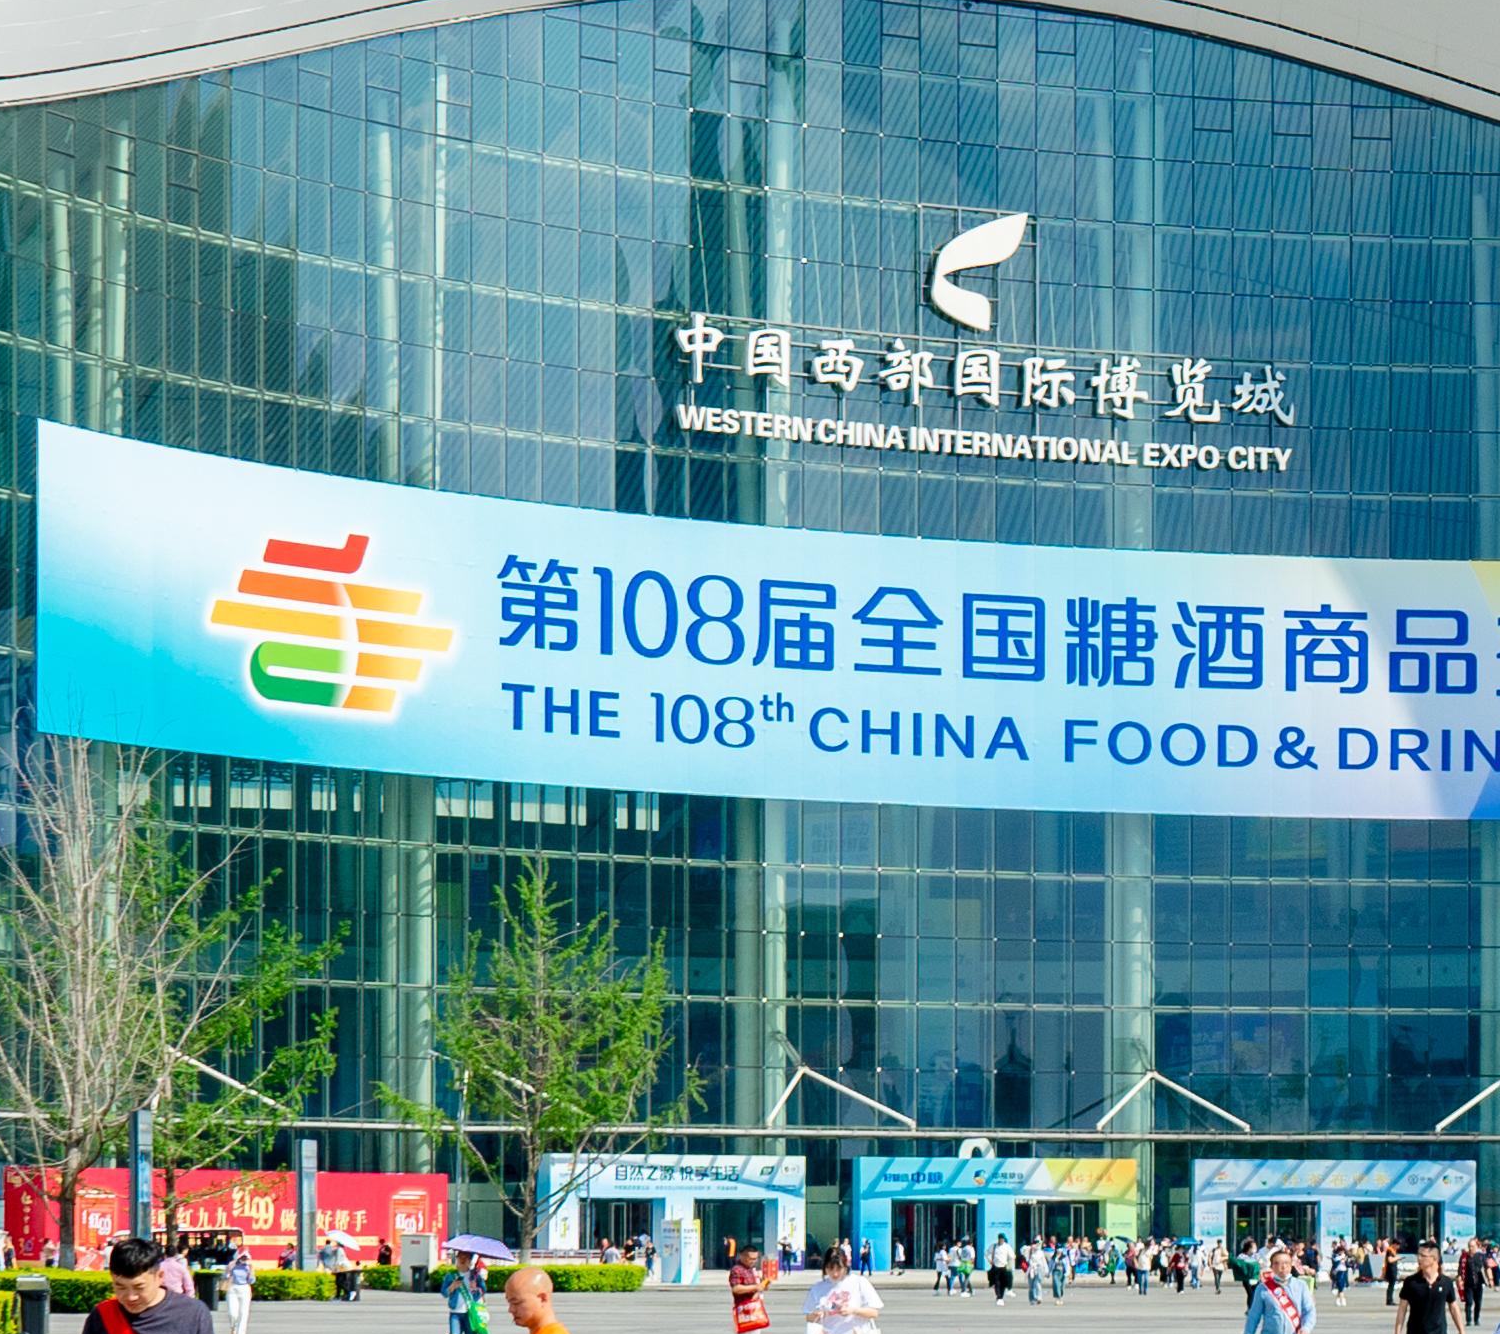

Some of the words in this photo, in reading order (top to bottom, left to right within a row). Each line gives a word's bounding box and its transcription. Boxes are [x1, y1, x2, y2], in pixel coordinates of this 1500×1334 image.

[676, 311, 1296, 427] 中国西部国际博览城
[678, 403, 814, 443] WESTERN
[816, 418, 906, 451] CHINA
[909, 428, 1138, 467] INTERNATIONAL
[1142, 441, 1221, 471] EXPO
[1227, 445, 1293, 473] CITY
[501, 683, 621, 739] THE
[653, 691, 795, 749] 108th
[809, 705, 1030, 761] CHINA
[615, 1165, 675, 1181] 自然之源
[681, 1165, 740, 1182] 悦享生活
[280, 1208, 368, 1232] 做好帮手
